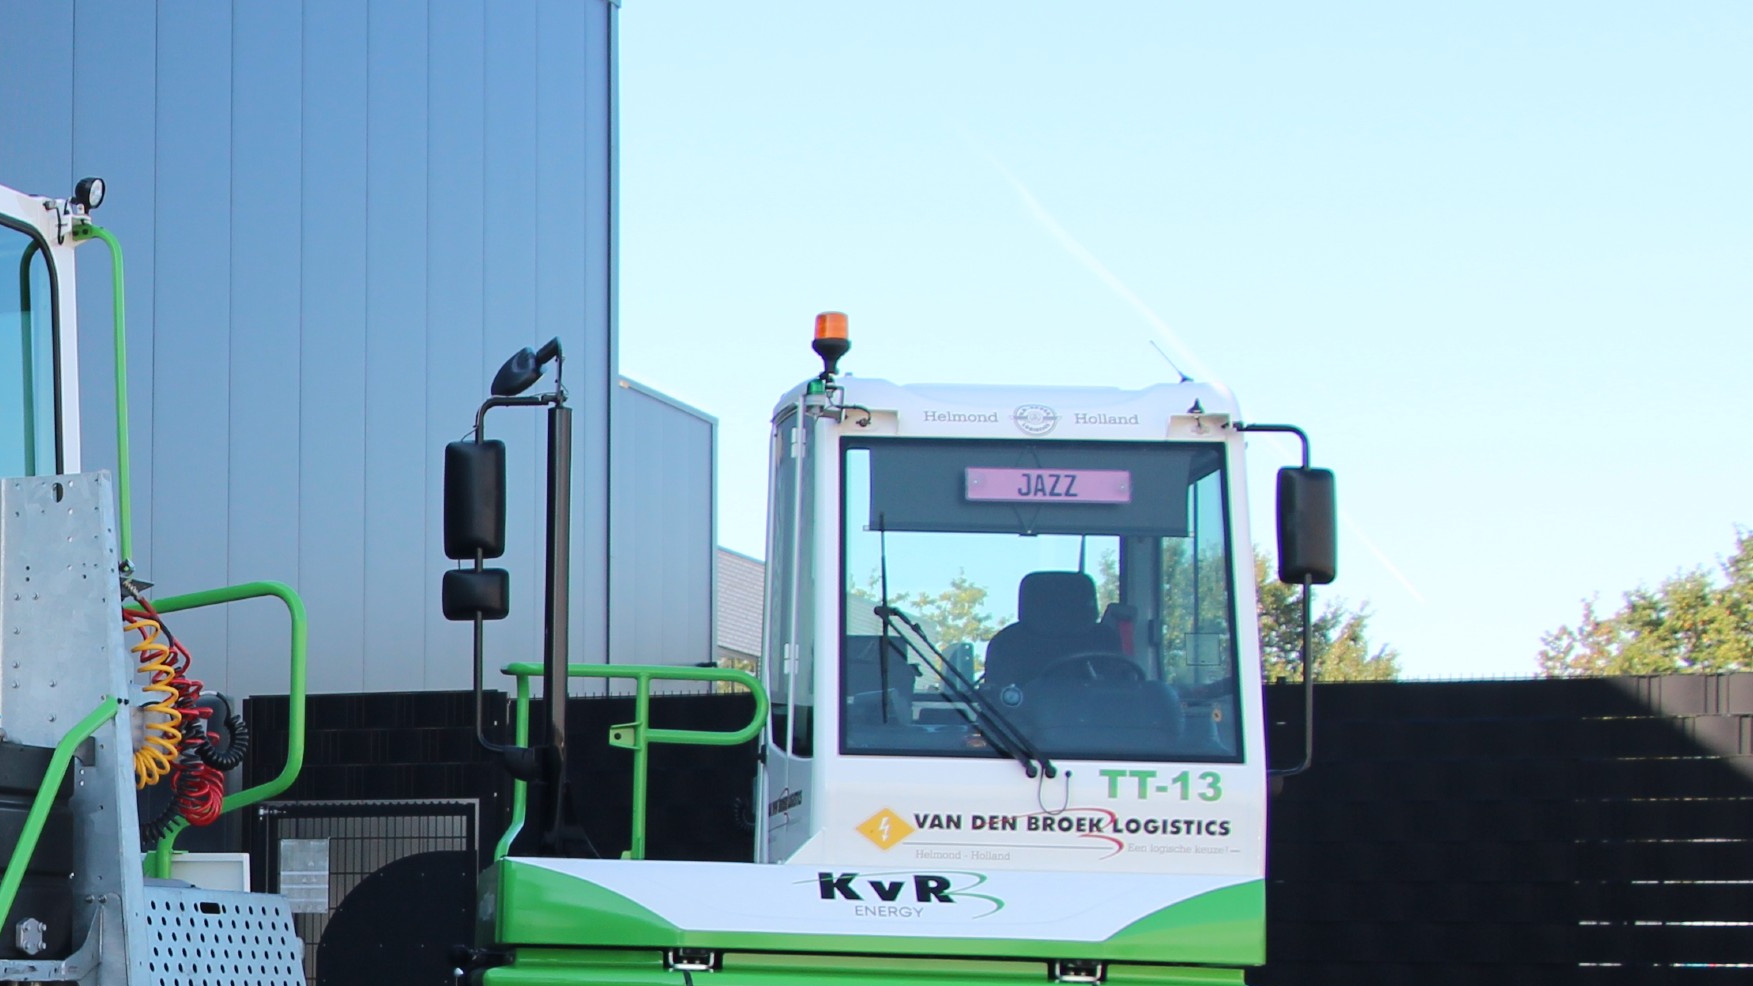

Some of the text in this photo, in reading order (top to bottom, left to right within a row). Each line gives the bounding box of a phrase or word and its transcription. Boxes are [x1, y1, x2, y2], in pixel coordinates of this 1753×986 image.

[923, 410, 999, 423] Helmond
[1074, 412, 1139, 425] Holland
[1017, 472, 1079, 498] JAZZ
[1099, 768, 1223, 802] TT-13
[914, 813, 1232, 837] VAN DEN BROEK LOGISTICS
[915, 849, 962, 860] Helmond
[970, 850, 1011, 861] Holland
[1127, 843, 1229, 856] Een logische keuze!
[817, 871, 958, 904] KvR
[854, 905, 925, 918] ENERGY
